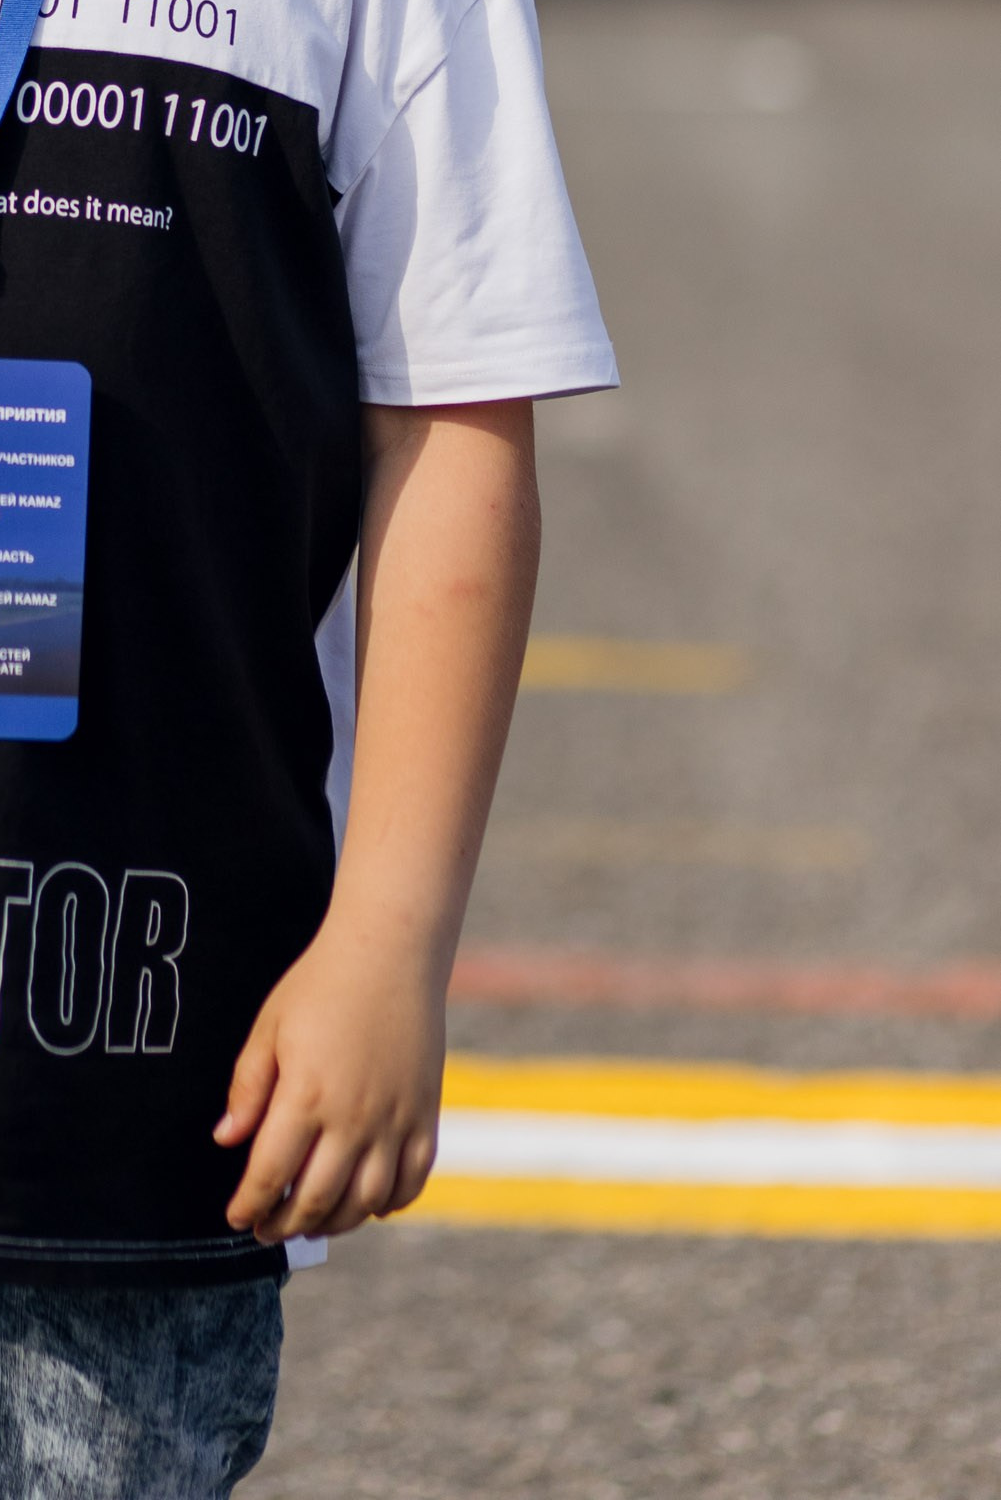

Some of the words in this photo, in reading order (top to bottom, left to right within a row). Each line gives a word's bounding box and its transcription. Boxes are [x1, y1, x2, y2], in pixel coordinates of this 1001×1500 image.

[16, 80, 145, 132] 00001
[163, 93, 268, 157] 11001
[23, 189, 80, 218] does
[86, 195, 101, 220] it
[107, 202, 173, 231] mean?
[18, 495, 62, 509] KAMAZ
[15, 593, 58, 607] KAMAZ
